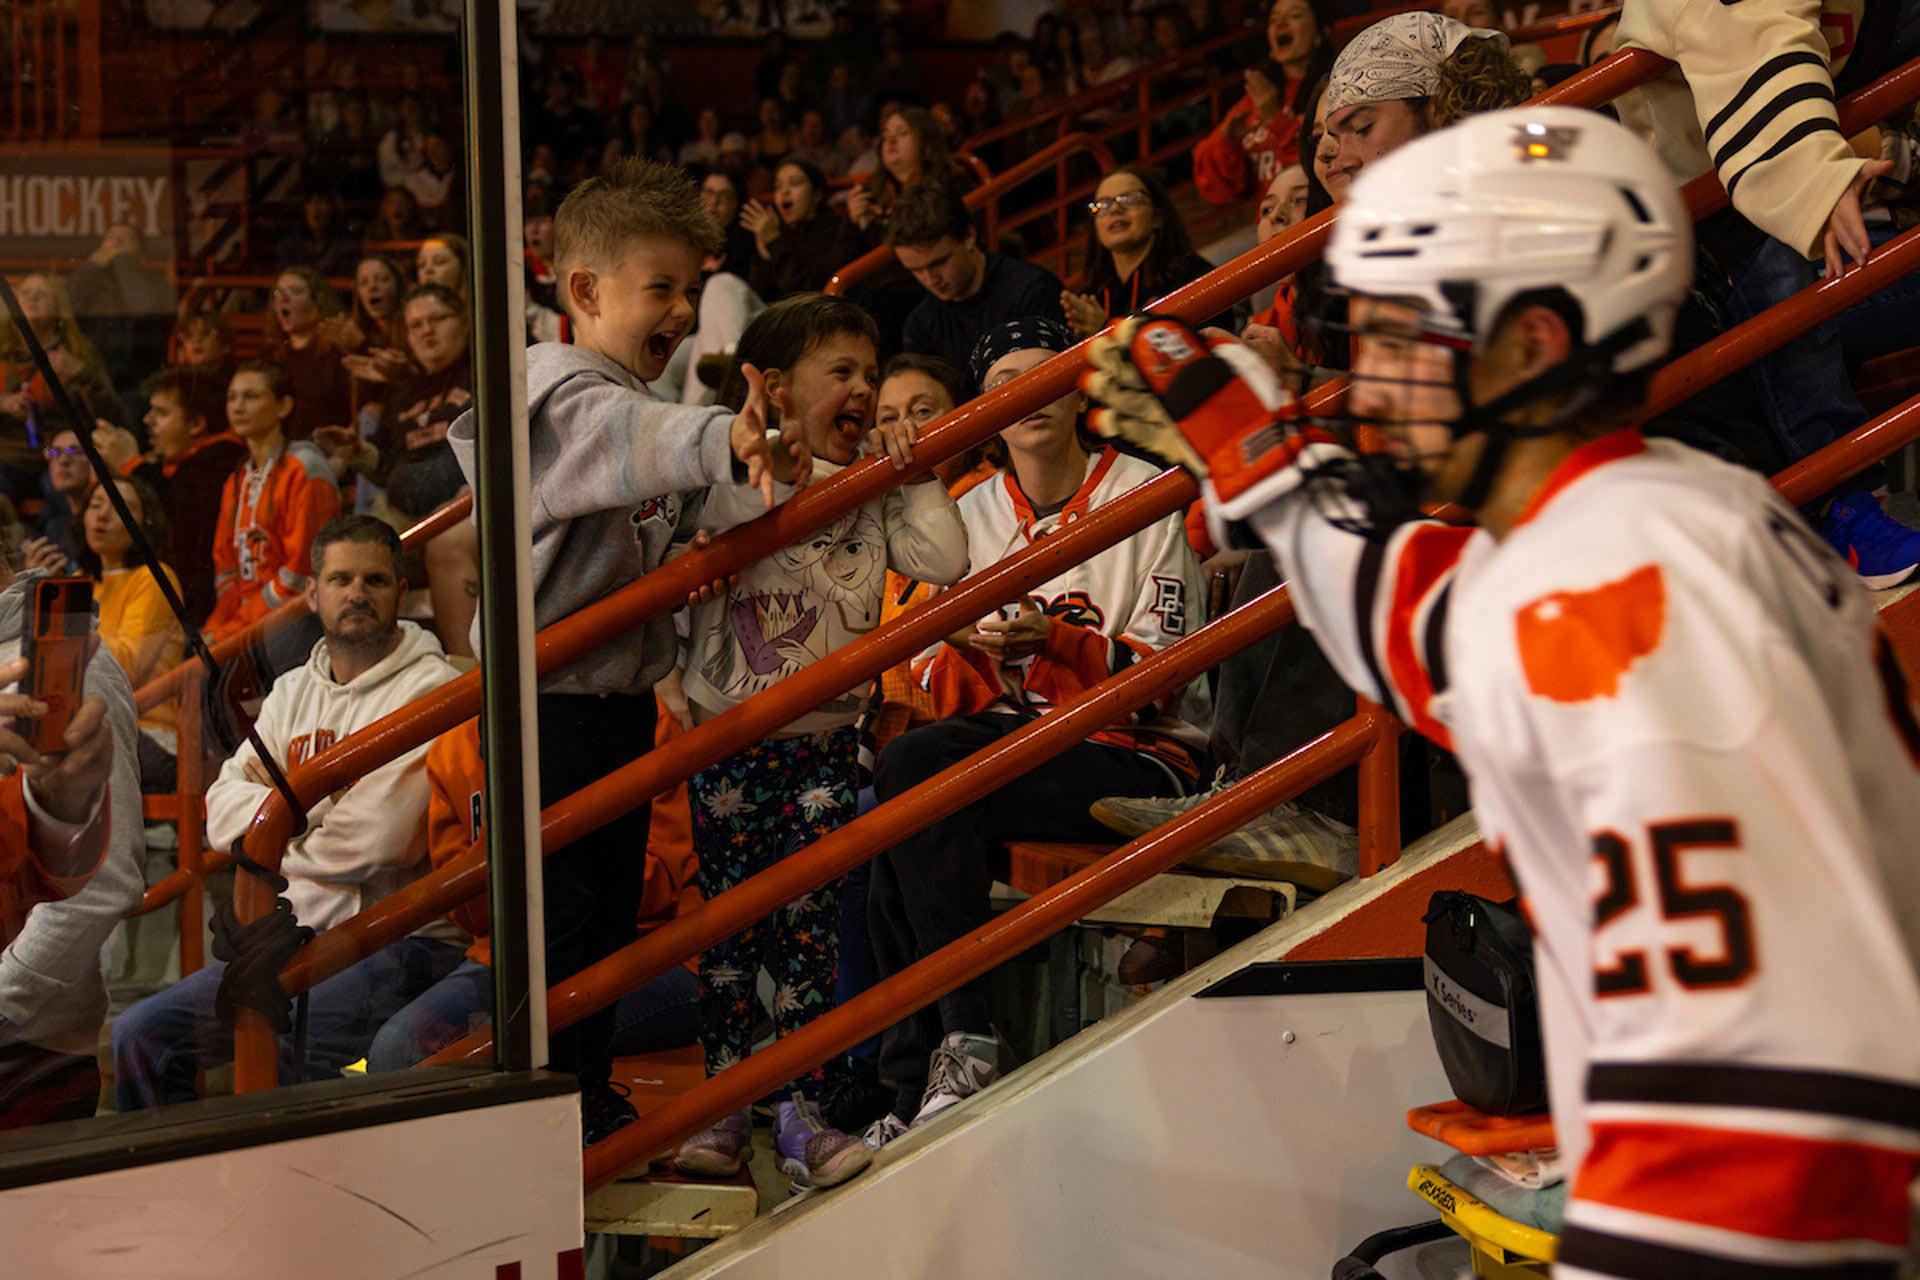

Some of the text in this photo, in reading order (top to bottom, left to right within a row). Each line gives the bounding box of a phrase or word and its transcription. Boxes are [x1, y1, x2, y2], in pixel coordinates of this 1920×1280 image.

[0, 175, 168, 236] HOCKEY
[1591, 817, 1757, 998] 25
[1441, 982, 1475, 1023] Series
